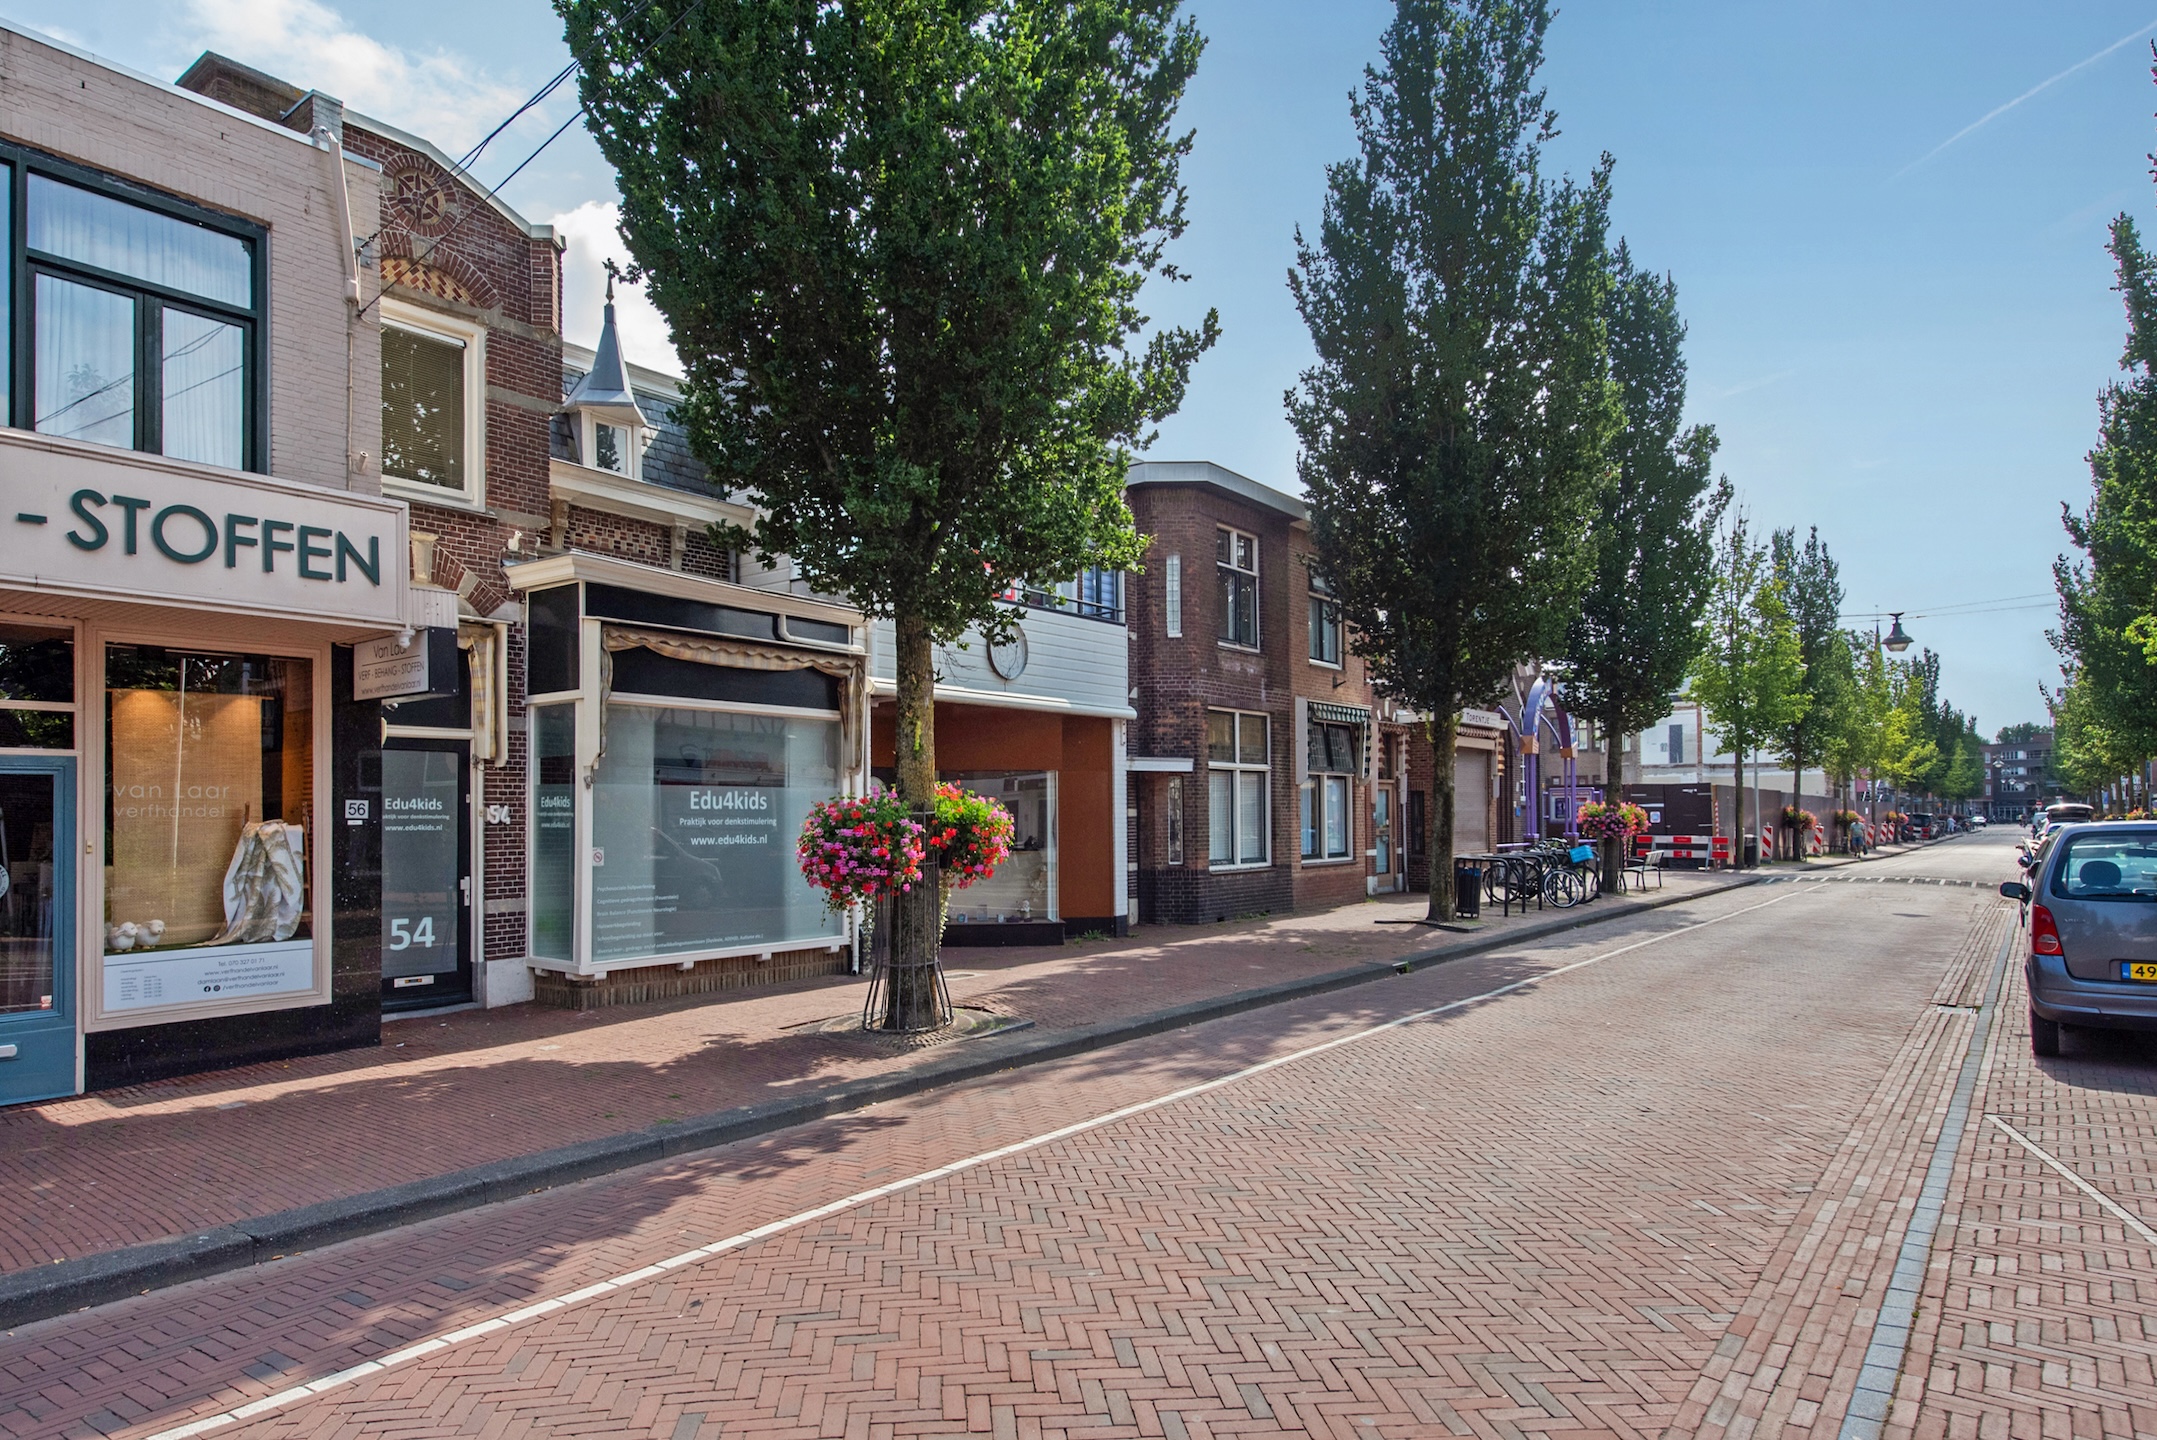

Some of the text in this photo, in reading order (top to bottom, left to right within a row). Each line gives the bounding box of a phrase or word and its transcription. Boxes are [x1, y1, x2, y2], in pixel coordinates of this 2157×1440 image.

[66, 488, 381, 587] STOFFEN
[373, 645, 389, 659] Van
[358, 669, 371, 681] VERF
[374, 665, 398, 679] BEHANG
[401, 661, 425, 675] STOFFEN
[361, 679, 422, 695] www.verfhandelvanlaar.nl
[1466, 712, 1491, 725] TORENTJE
[113, 782, 230, 799] van Laar
[384, 797, 443, 811] Edu4kids
[541, 795, 570, 808] Edu4kids
[690, 790, 768, 810] Edu4kids
[114, 803, 226, 818] verfhandel
[348, 802, 366, 816] 56
[488, 804, 511, 825] 54
[385, 824, 443, 832] www.edu4kids.nl
[679, 817, 777, 827] Praktijk voor denkstimulering
[690, 834, 768, 846] www.edu4kids.nl
[389, 916, 436, 951] 54
